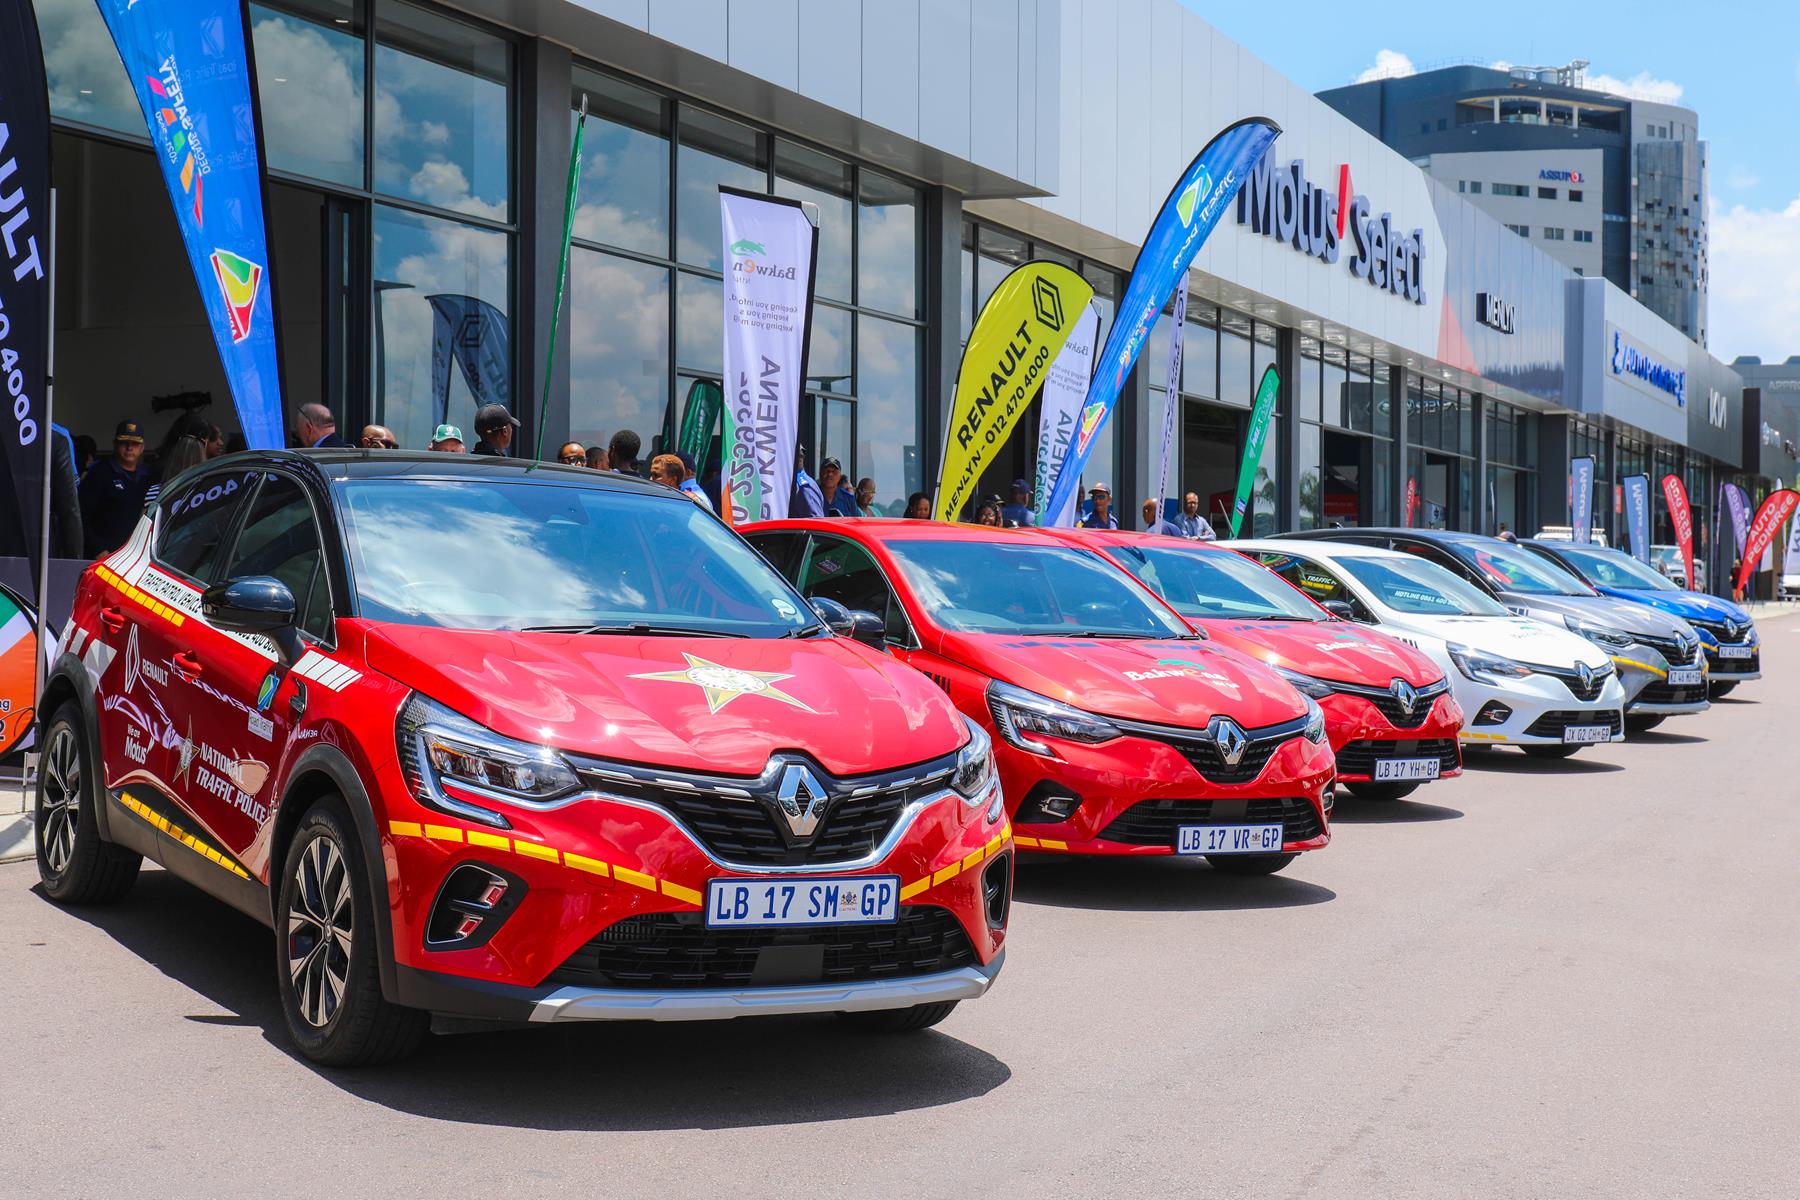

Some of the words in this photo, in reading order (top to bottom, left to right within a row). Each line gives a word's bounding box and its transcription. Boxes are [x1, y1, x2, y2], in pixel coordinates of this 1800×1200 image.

[1538, 169, 1585, 183] ASSUPOL
[0, 121, 43, 282] ULT
[1236, 143, 1340, 265] Motus
[1349, 194, 1427, 306] Select
[1485, 291, 1516, 334] MENLYN
[1, 346, 37, 446] 4000
[957, 319, 1033, 450] RENAULT
[945, 450, 982, 521] MENLYN
[985, 415, 1008, 445] 012
[1006, 384, 1026, 417] 470
[1023, 345, 1050, 387] 4000
[1747, 493, 1795, 565] PEDIGREE
[1751, 502, 1776, 542] AUTO
[142, 573, 167, 595] TRAFFIC
[161, 580, 183, 602] PATROL
[177, 590, 202, 614] VEHICLE
[1306, 575, 1332, 585] TRAFFIC
[1394, 590, 1420, 600] HOTLINE
[142, 658, 169, 688] RENAULT
[125, 736, 148, 765] Motus
[200, 741, 244, 784] NATIONAL
[1378, 761, 1391, 778] LB
[1394, 761, 1406, 777] 17
[1409, 761, 1420, 777] YH
[1427, 761, 1438, 776] GP
[195, 766, 235, 804] TRAFFIC
[233, 789, 267, 826] POLICE
[1182, 829, 1201, 850] LB
[1208, 829, 1227, 850] 17
[1233, 828, 1250, 849] VR
[1261, 827, 1279, 848] GP
[715, 886, 750, 920] LB
[762, 885, 796, 919] 17
[807, 885, 840, 918] SM
[860, 883, 892, 916] GP
